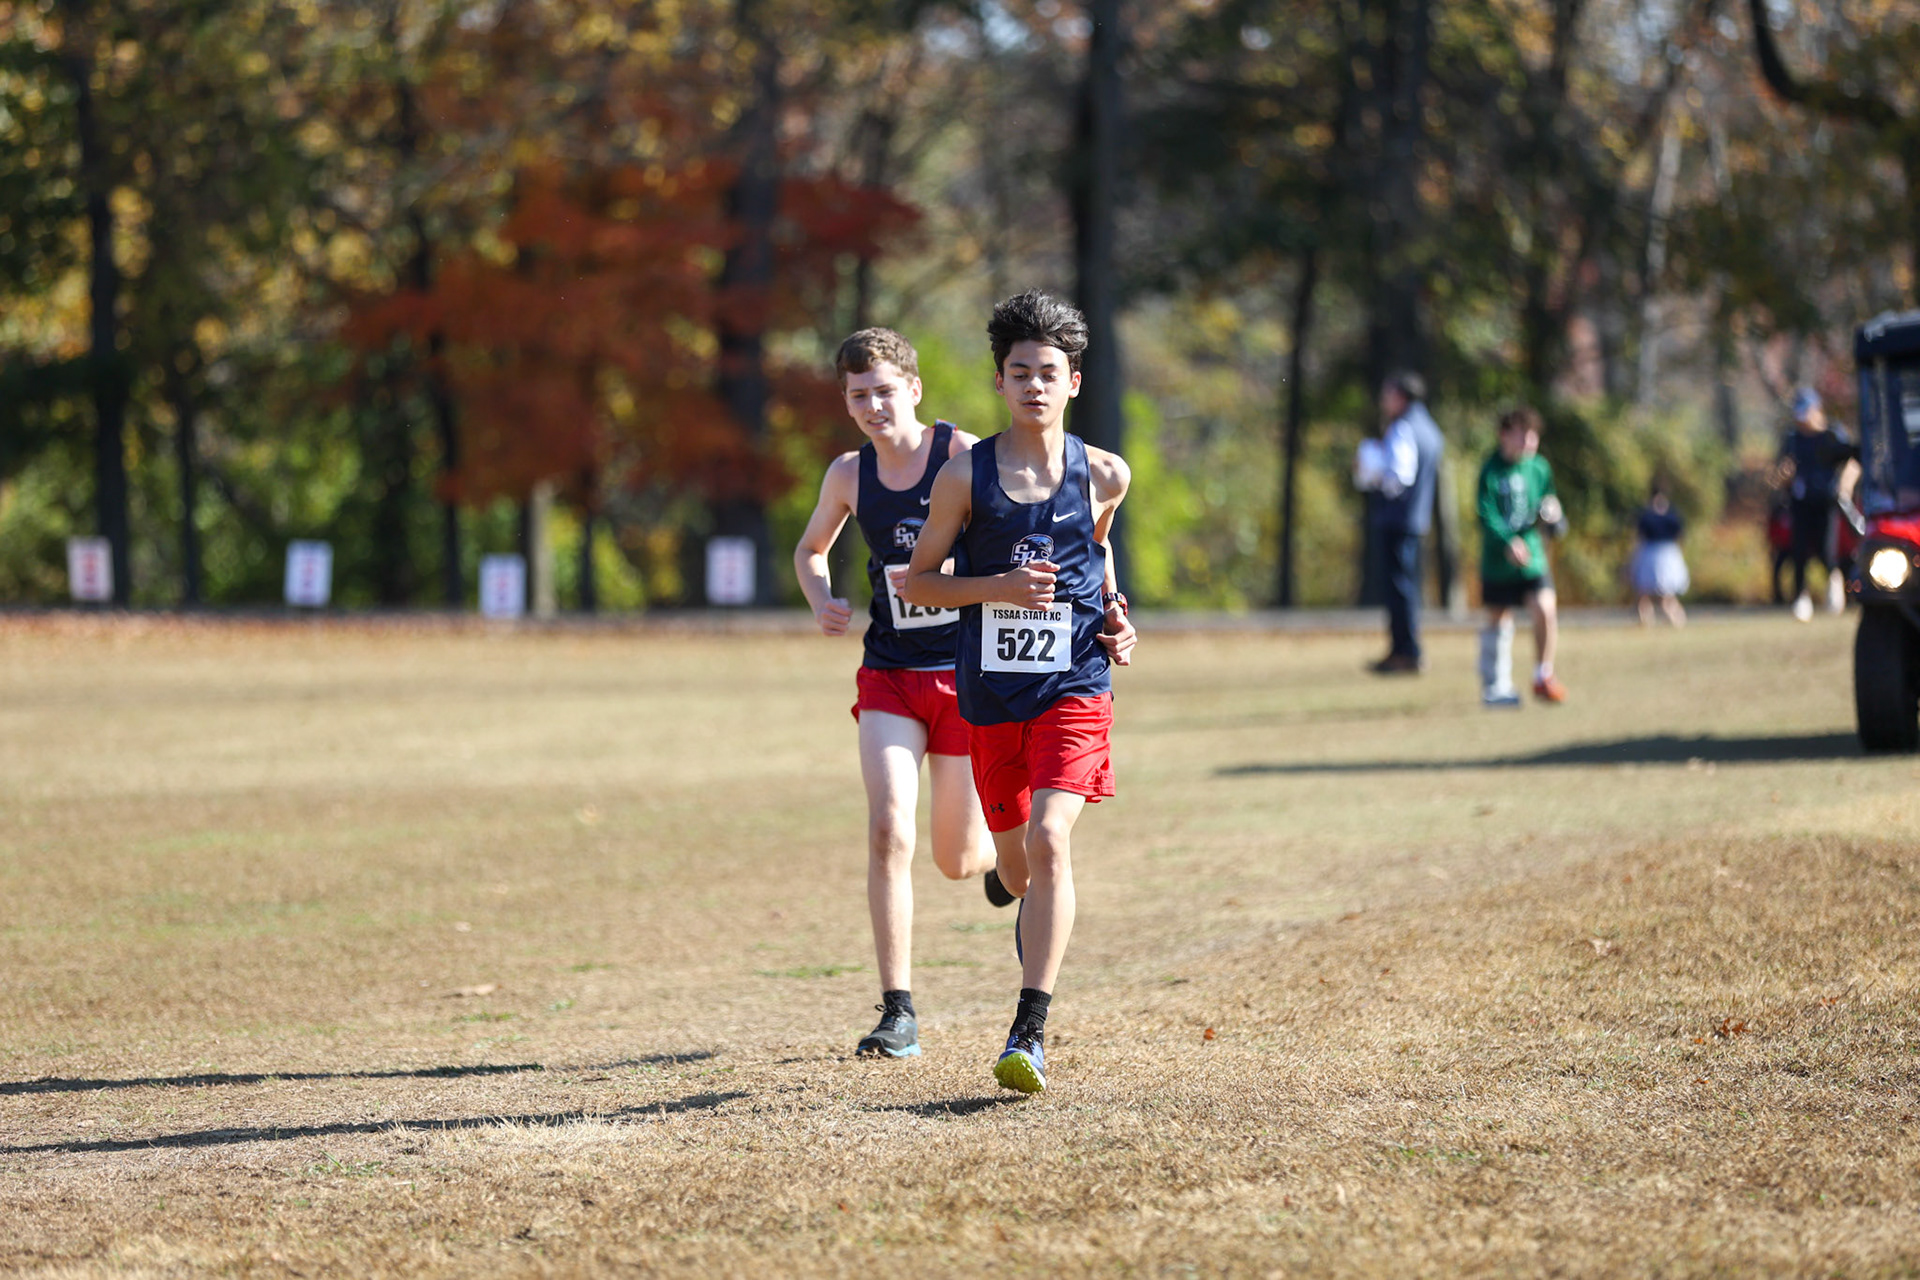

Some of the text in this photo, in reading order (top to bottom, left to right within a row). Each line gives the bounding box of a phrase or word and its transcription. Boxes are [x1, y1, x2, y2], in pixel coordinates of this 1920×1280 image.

[893, 593, 958, 618] 12
[992, 609, 1062, 621] TSSAA STATE XC
[996, 628, 1056, 662] 522
